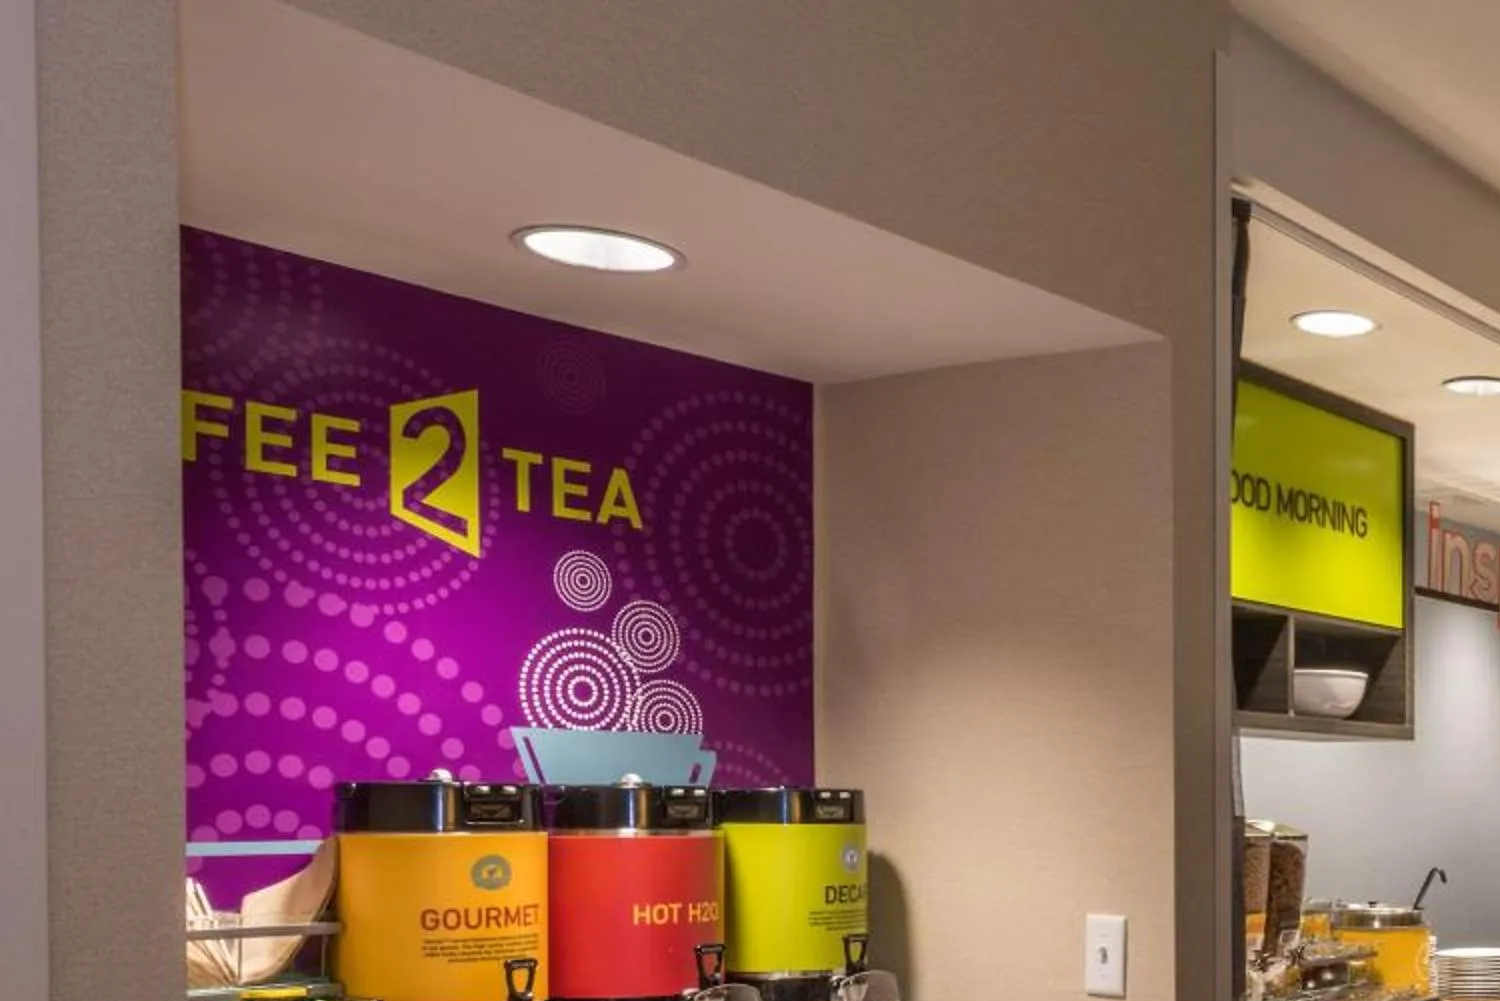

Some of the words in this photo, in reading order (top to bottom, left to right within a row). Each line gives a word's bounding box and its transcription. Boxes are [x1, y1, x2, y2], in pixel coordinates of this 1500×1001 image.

[400, 404, 471, 540] 2
[502, 446, 644, 530] TEA
[1276, 481, 1368, 540] MORNING
[420, 903, 539, 931] GOURMET
[633, 902, 682, 926] HOT
